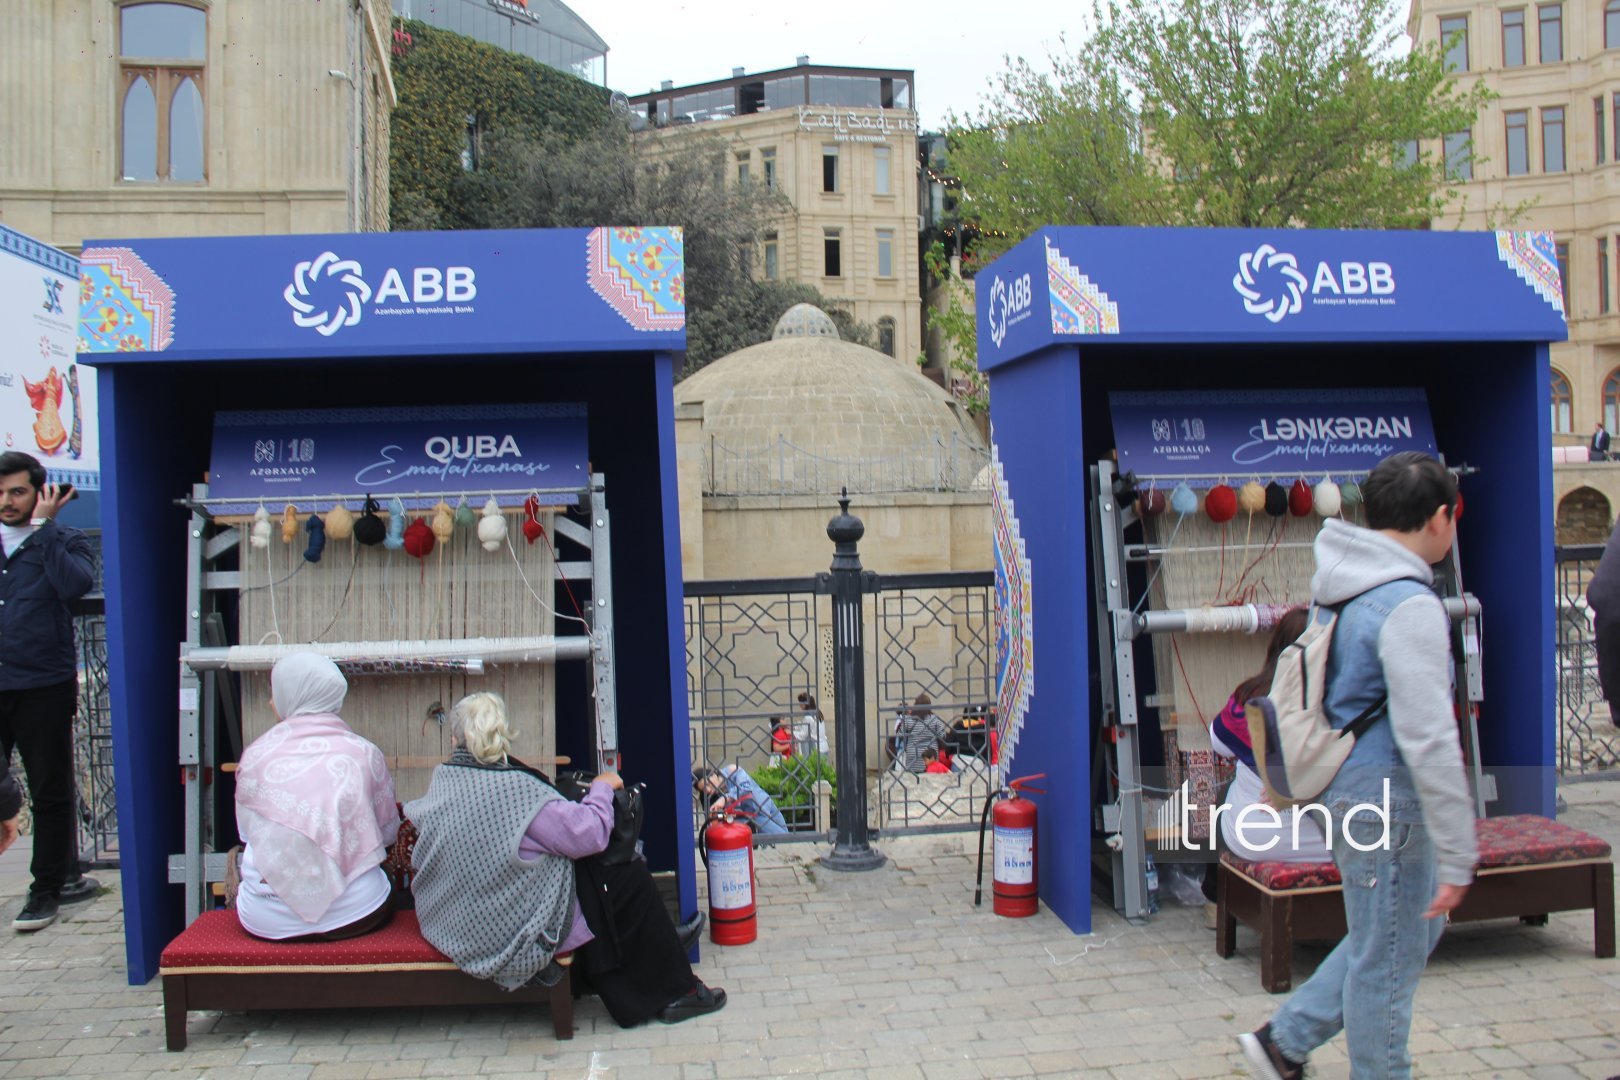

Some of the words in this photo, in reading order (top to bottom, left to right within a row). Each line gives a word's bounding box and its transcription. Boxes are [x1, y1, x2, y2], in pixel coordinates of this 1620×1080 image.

[374, 266, 477, 304] ABB
[1312, 261, 1396, 295] ABB
[1007, 273, 1032, 317] ABB
[1181, 417, 1206, 442] 10
[1261, 416, 1413, 441] LƏNKƏRAN
[287, 437, 315, 463] 10
[424, 434, 523, 465] QUBA
[249, 466, 317, 477] AZƏRXALÇA
